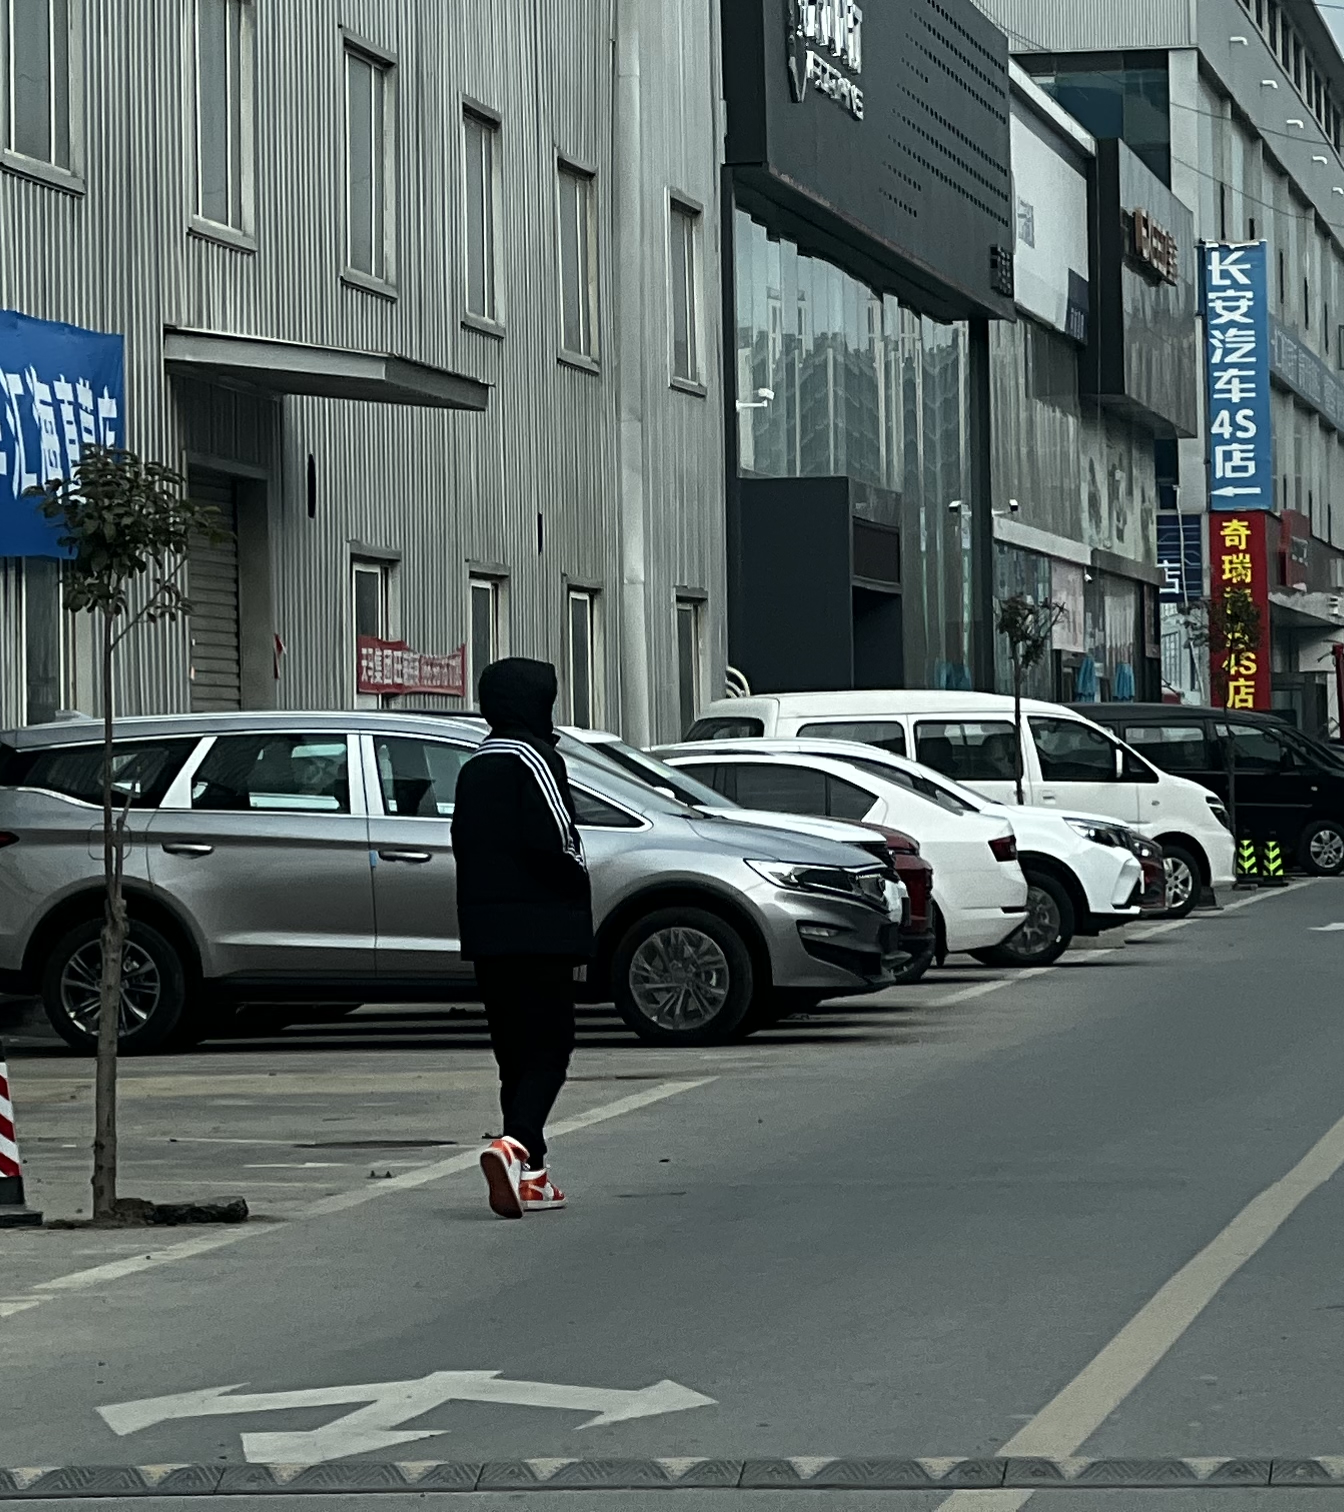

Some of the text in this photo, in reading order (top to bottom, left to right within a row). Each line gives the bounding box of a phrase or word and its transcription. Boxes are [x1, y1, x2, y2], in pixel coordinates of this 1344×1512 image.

[1207, 250, 1257, 479] 长安汽车4S店
[1220, 518, 1257, 709] 奇瑞4S店
